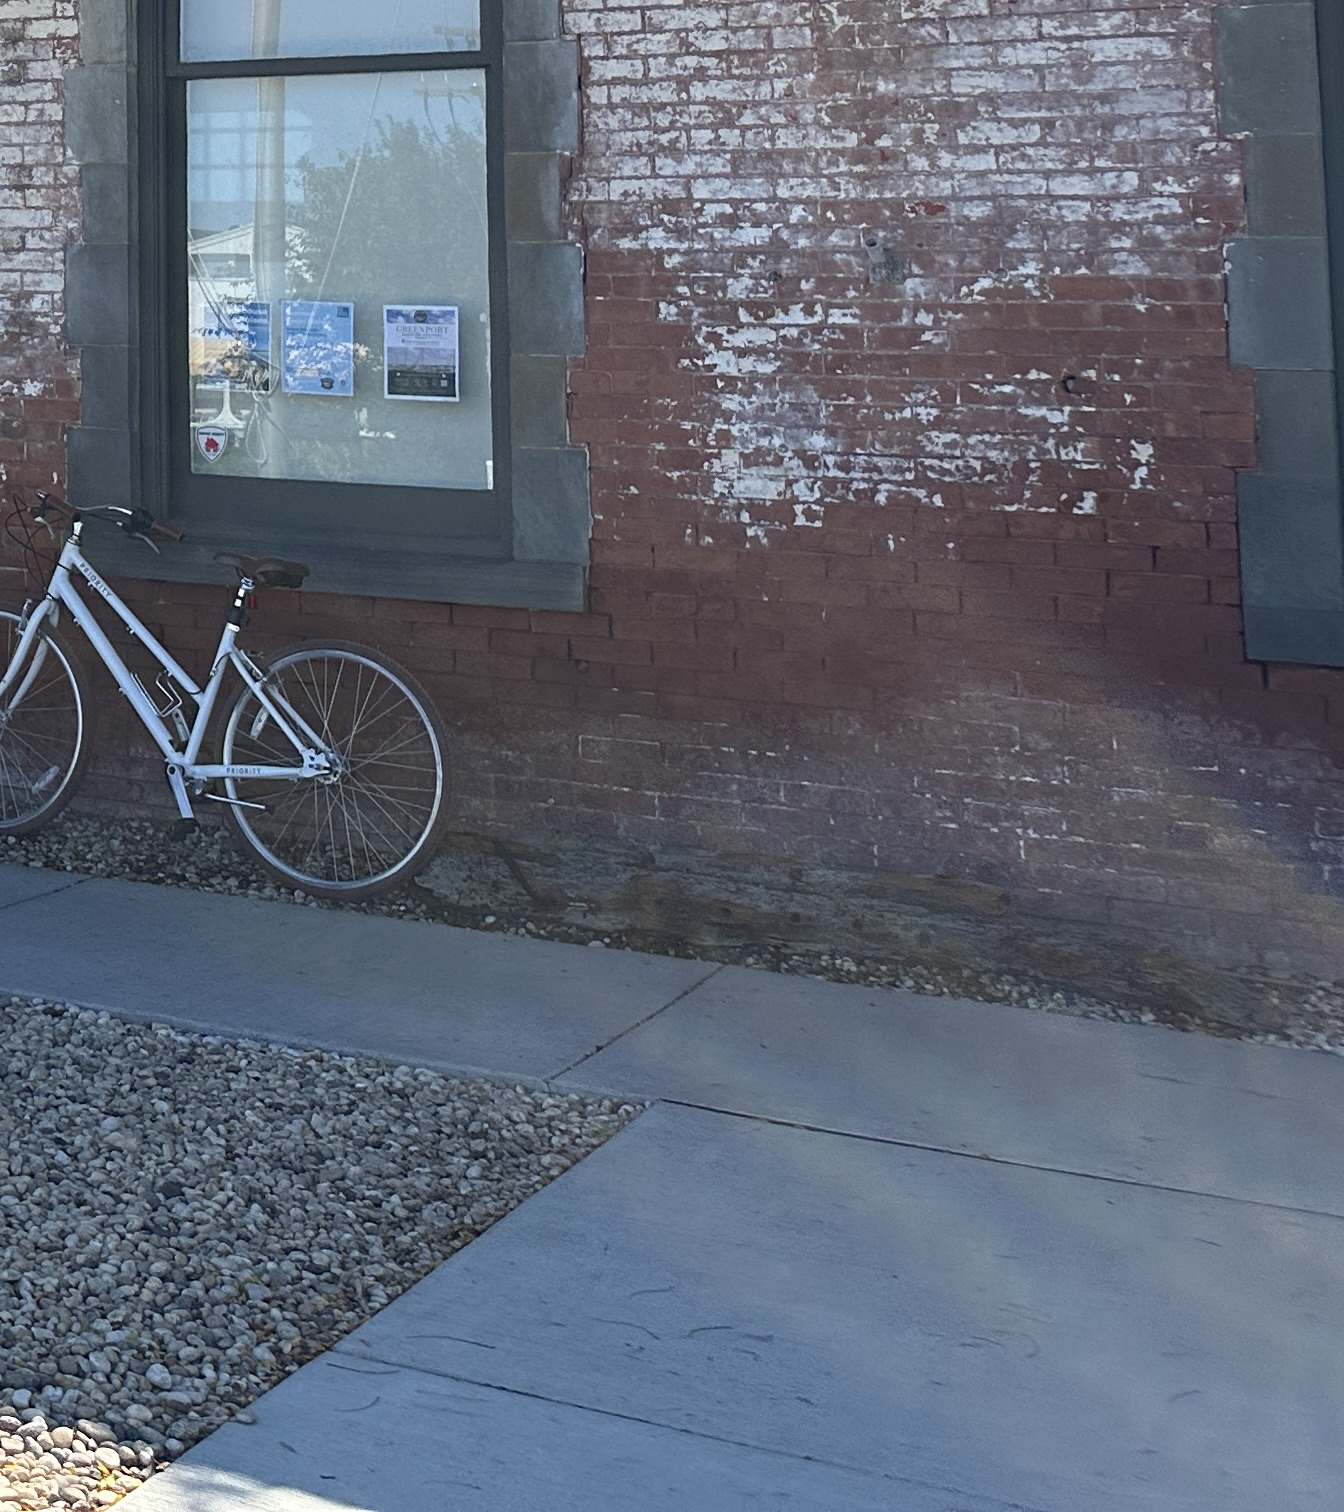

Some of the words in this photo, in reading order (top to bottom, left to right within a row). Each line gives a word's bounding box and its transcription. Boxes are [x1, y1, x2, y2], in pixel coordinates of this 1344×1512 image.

[396, 325, 449, 334] GREENPORT
[79, 562, 113, 597] PRIORITY
[225, 766, 262, 775] PRIORITY
